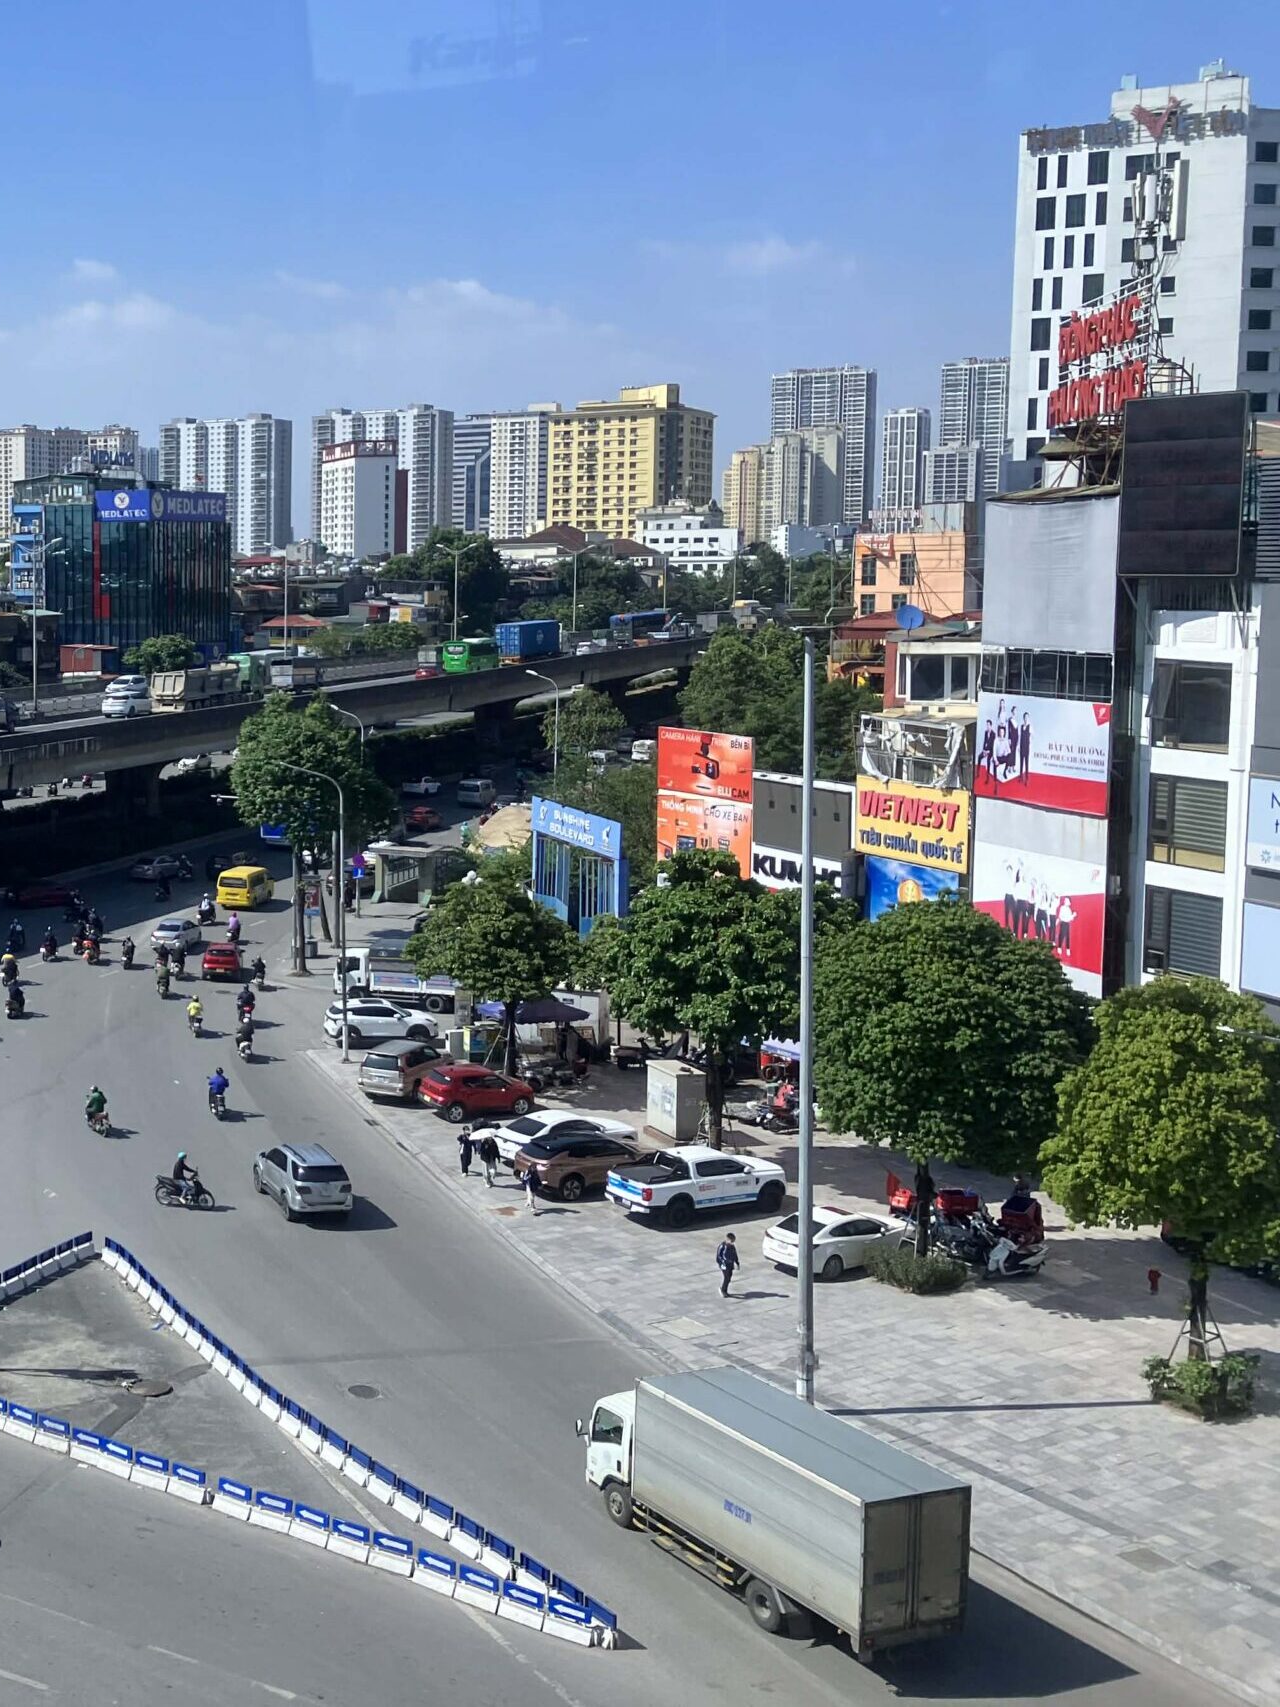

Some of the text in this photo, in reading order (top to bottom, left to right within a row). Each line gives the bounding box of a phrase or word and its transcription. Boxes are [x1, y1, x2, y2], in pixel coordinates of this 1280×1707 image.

[167, 497, 224, 515] MEDLATEC
[660, 730, 685, 742] CAMERA
[553, 809, 591, 830] SUNSHINE
[661, 799, 685, 813] THÔNG
[704, 807, 721, 818] CHO
[722, 808, 732, 821] XE
[859, 790, 960, 832] VIETNEST
[549, 822, 594, 846] BOULEVARD
[859, 827, 965, 864] TIÊU CHUẨN QUỐC TẾ
